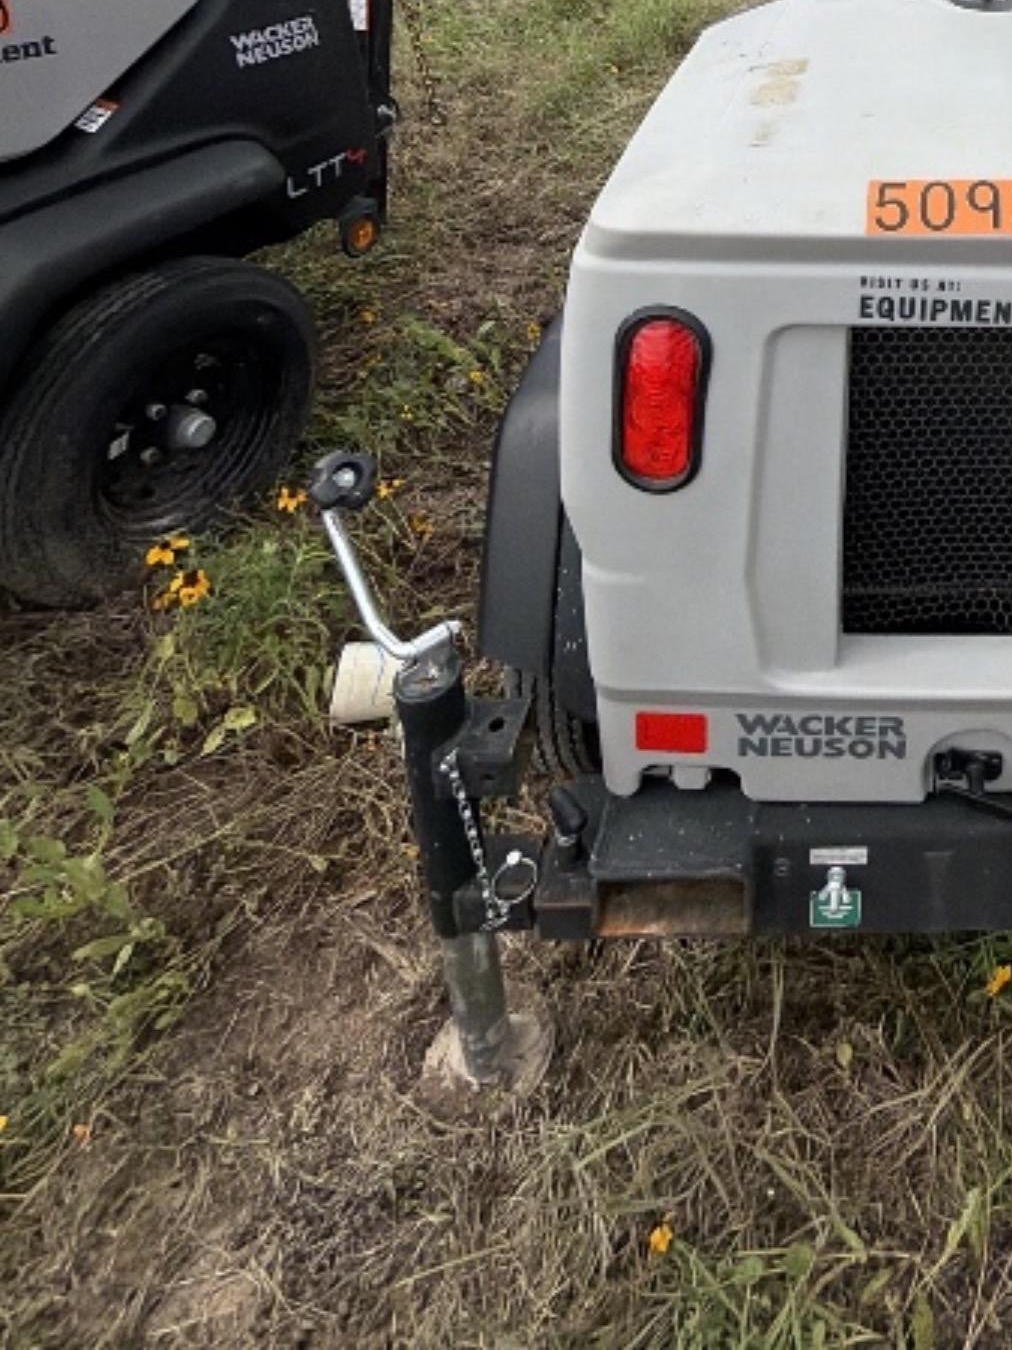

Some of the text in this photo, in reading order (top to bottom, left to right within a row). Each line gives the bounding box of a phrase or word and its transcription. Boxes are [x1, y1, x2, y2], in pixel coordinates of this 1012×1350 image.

[229, 14, 315, 52] WACKER
[235, 29, 320, 68] NEUSON
[735, 713, 905, 736] WACKER
[737, 736, 907, 760] NEUSON
